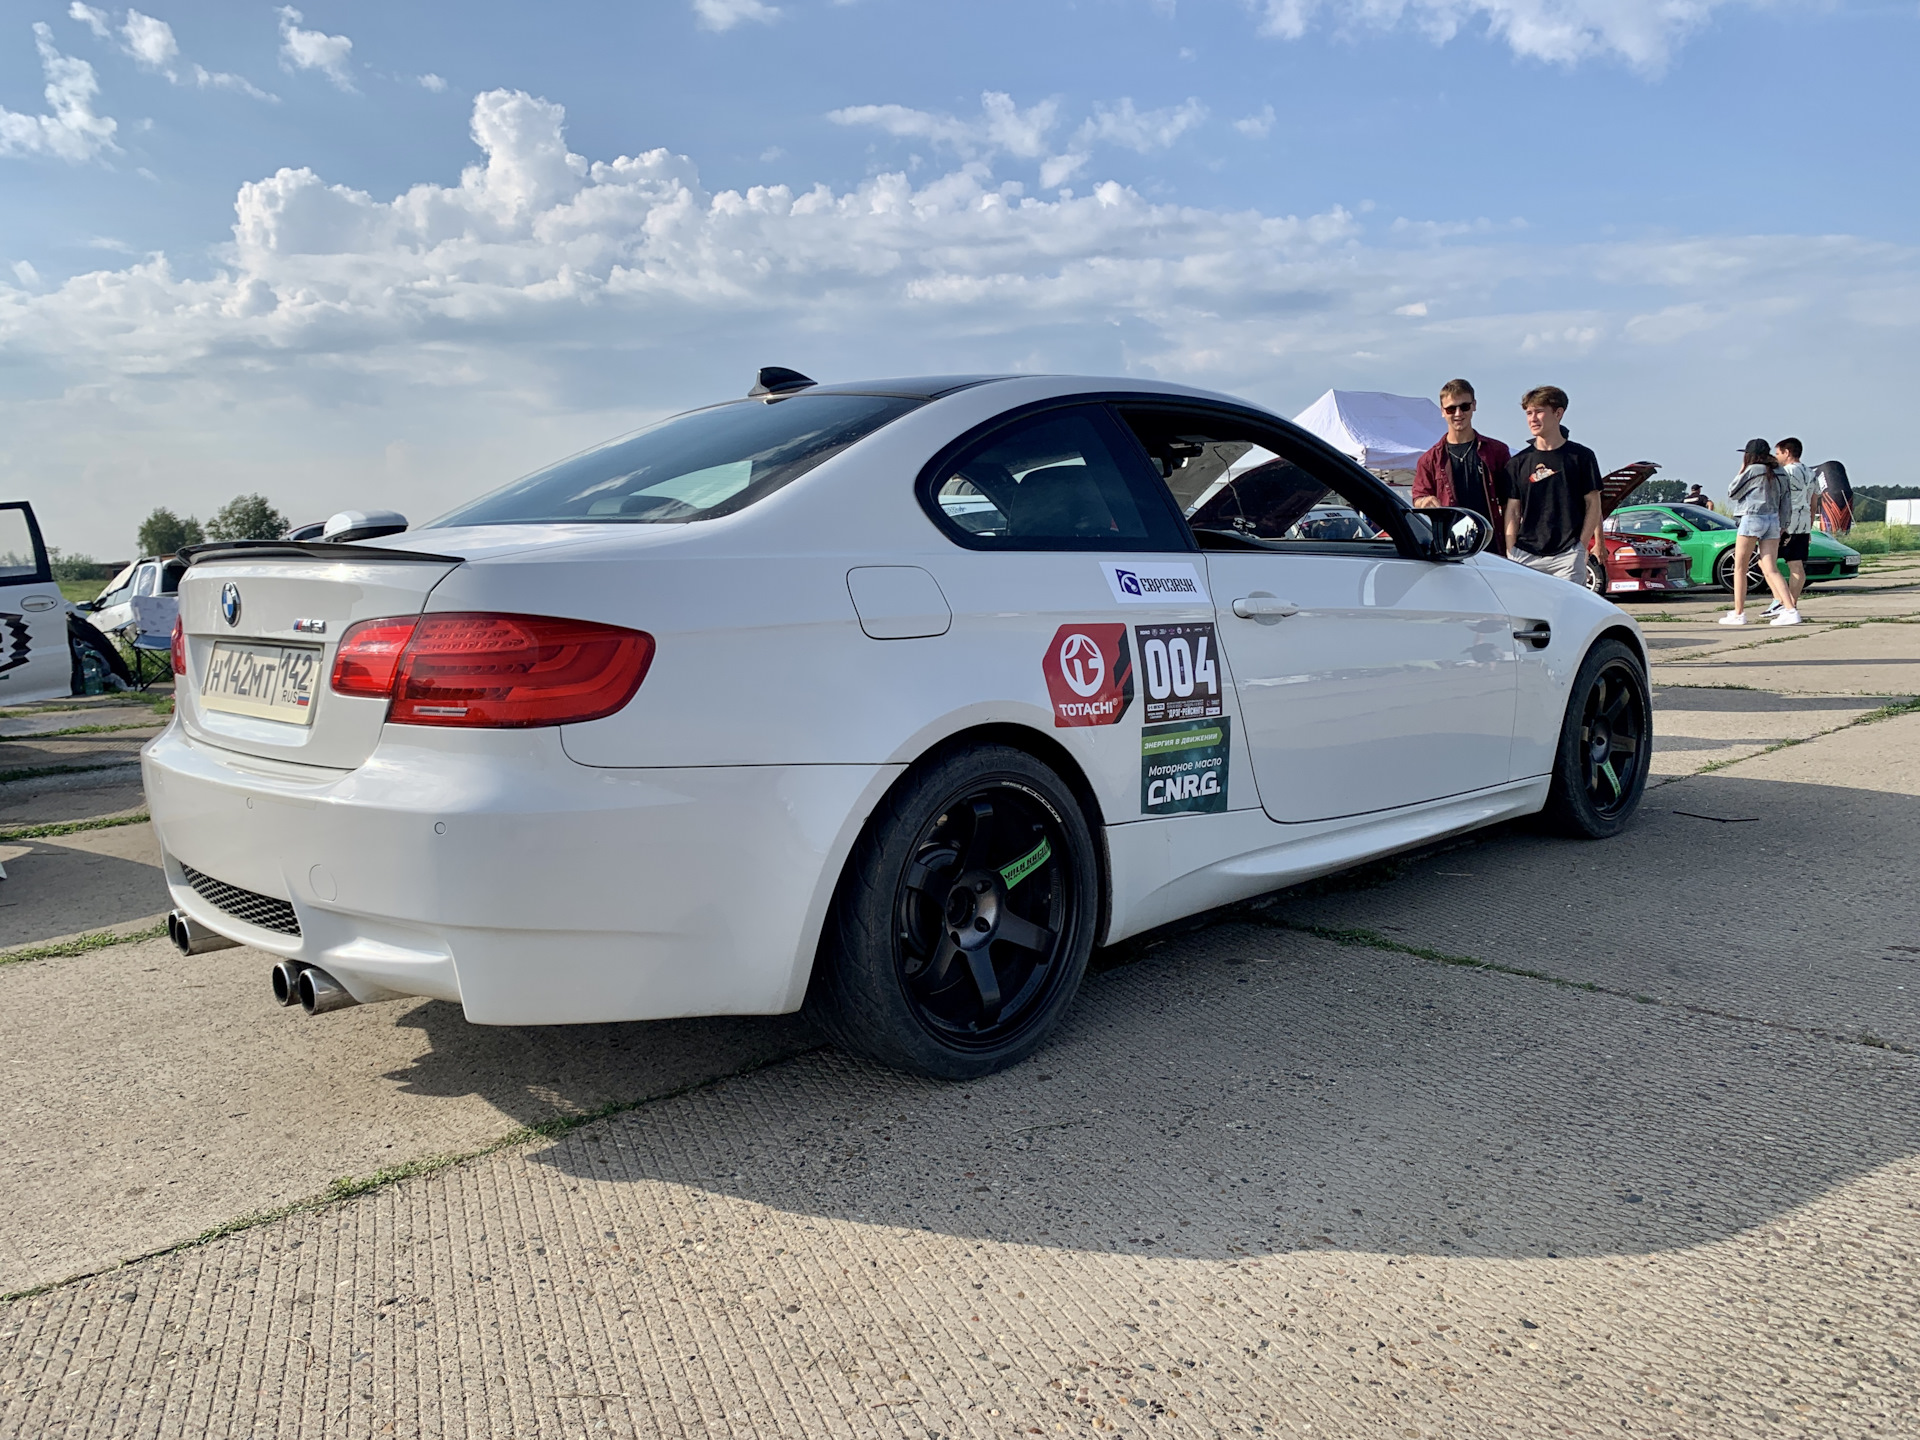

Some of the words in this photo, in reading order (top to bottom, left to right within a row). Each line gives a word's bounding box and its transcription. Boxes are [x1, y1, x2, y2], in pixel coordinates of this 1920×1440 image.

[281, 653, 312, 690] 142
[1144, 637, 1218, 700] 004
[281, 690, 298, 704] RUS
[1059, 700, 1115, 717] TOTACHI
[1144, 738, 1174, 750] ЭНЕРГИЯ
[1181, 733, 1218, 746] ДВИЖЕНИИ
[1148, 762, 1193, 777] Моторное
[1194, 757, 1222, 769] масло
